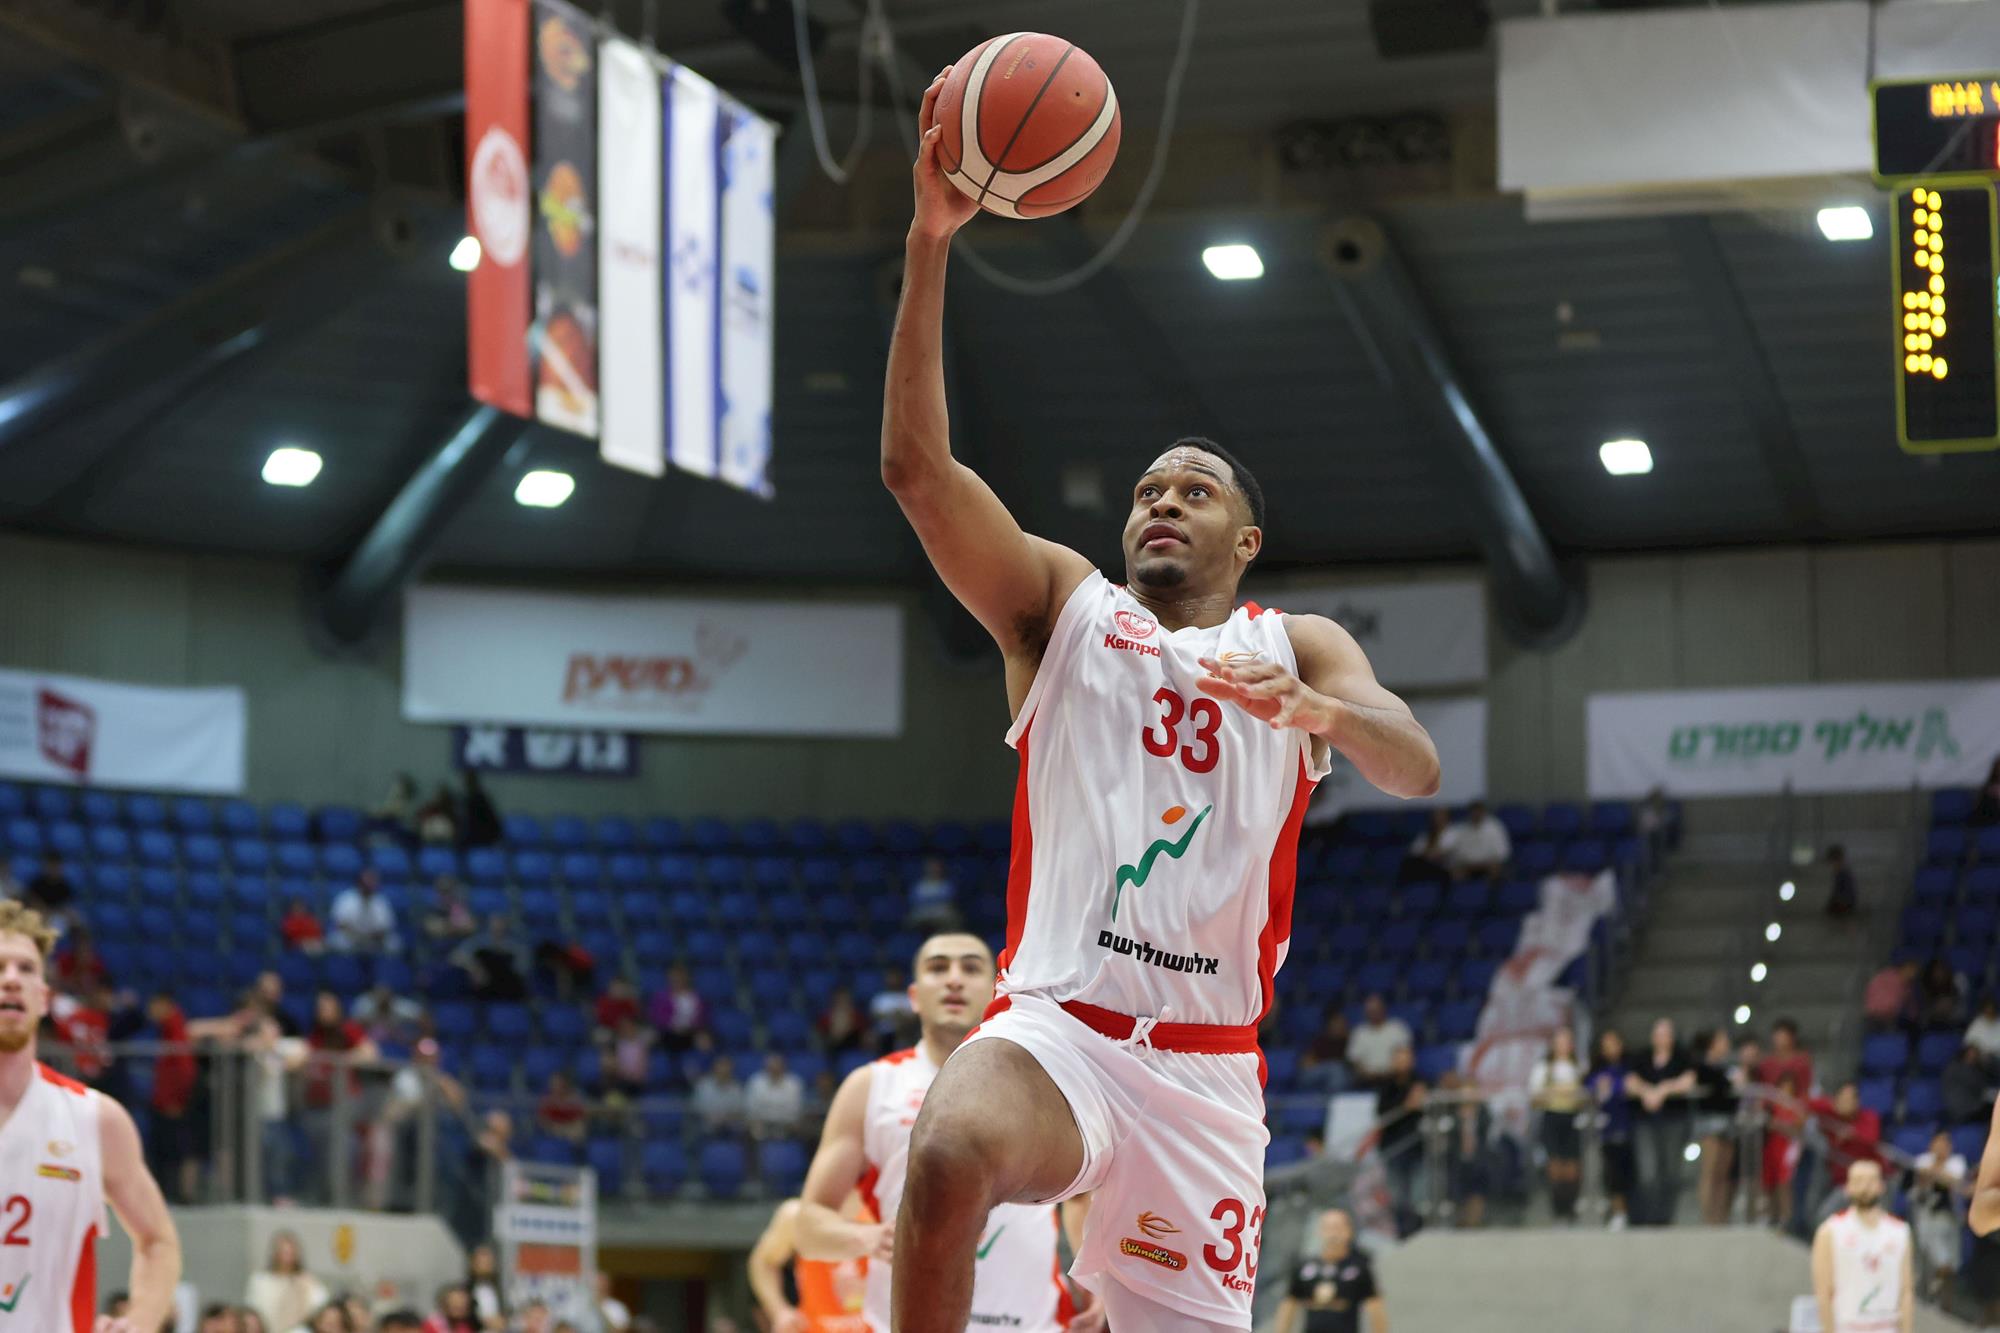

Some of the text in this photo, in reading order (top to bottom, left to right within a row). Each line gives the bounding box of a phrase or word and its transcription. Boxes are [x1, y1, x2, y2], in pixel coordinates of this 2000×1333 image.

[1103, 633, 1161, 657] Kempa
[1142, 686, 1222, 774] 33
[1667, 707, 1914, 763] אלוף ספורט
[1126, 1242, 1168, 1263] Winner
[1203, 1198, 1266, 1279] 33
